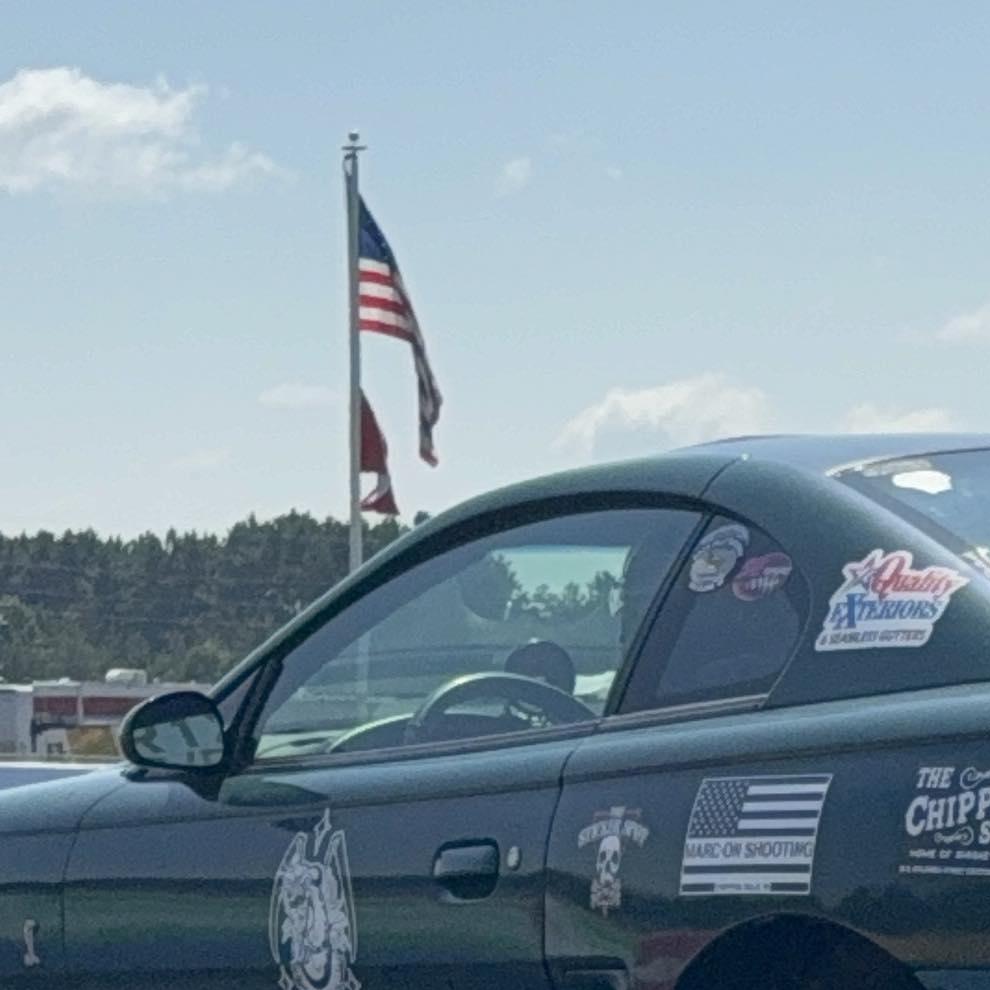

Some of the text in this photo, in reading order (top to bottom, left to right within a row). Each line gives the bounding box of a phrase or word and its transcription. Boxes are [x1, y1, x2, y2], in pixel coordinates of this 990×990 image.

[871, 555, 952, 600] Quality
[829, 593, 943, 629] EXTERIORS
[916, 767, 955, 788] THE
[744, 841, 814, 859] SHOOTING
